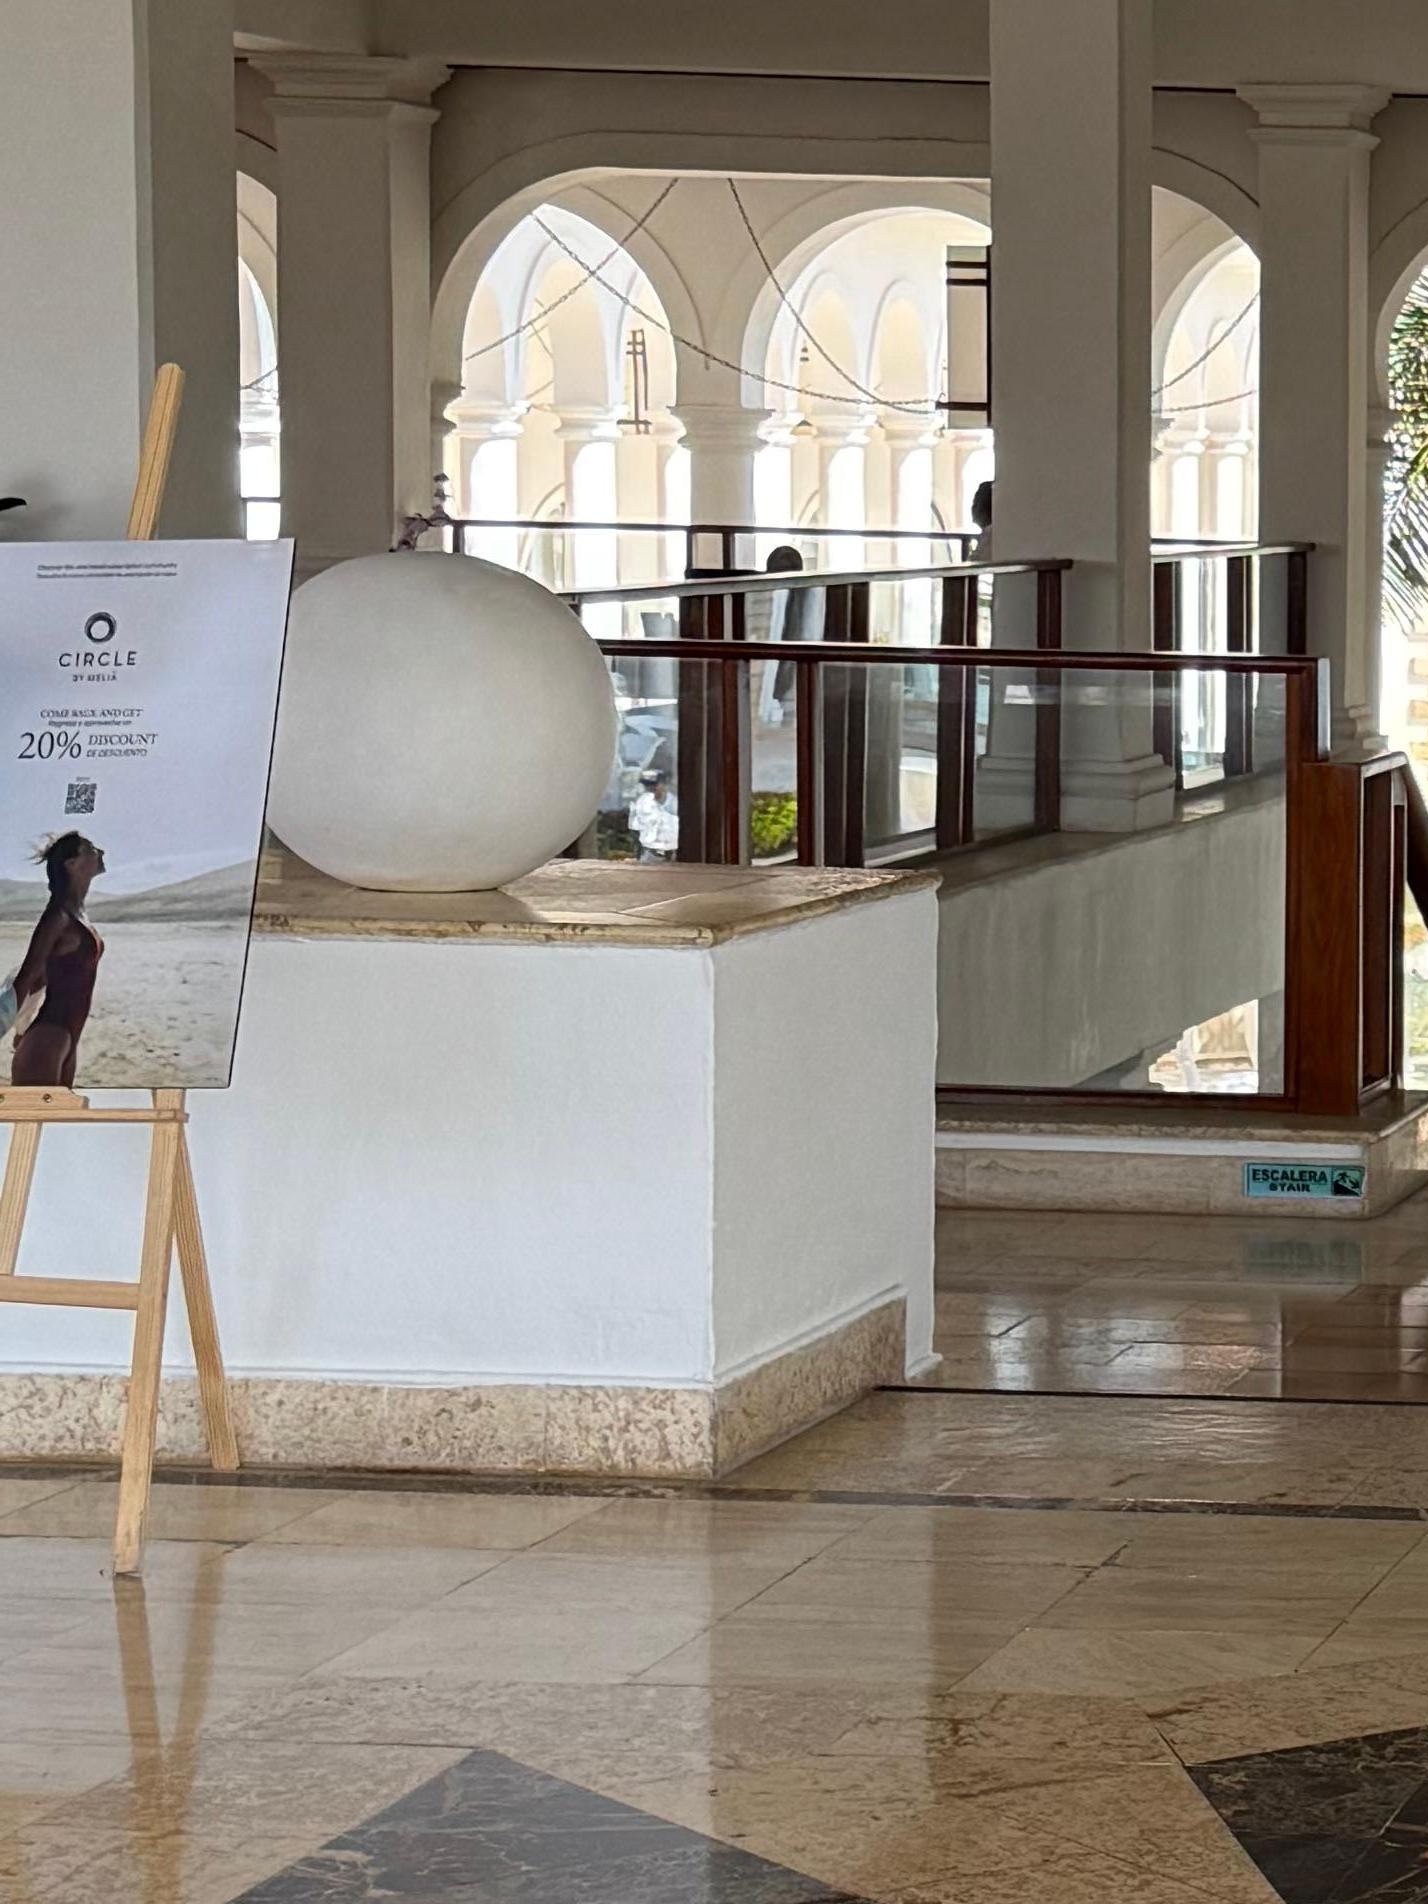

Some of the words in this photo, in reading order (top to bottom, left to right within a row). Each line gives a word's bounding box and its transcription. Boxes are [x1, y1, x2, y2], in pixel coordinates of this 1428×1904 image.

[58, 650, 137, 667] CIRCLE
[123, 708, 144, 717] GET
[17, 730, 82, 760] 20%
[87, 733, 159, 746] DISCOUNT
[1252, 1169, 1327, 1183] ESCALERA
[1269, 1183, 1311, 1192] STAIR
